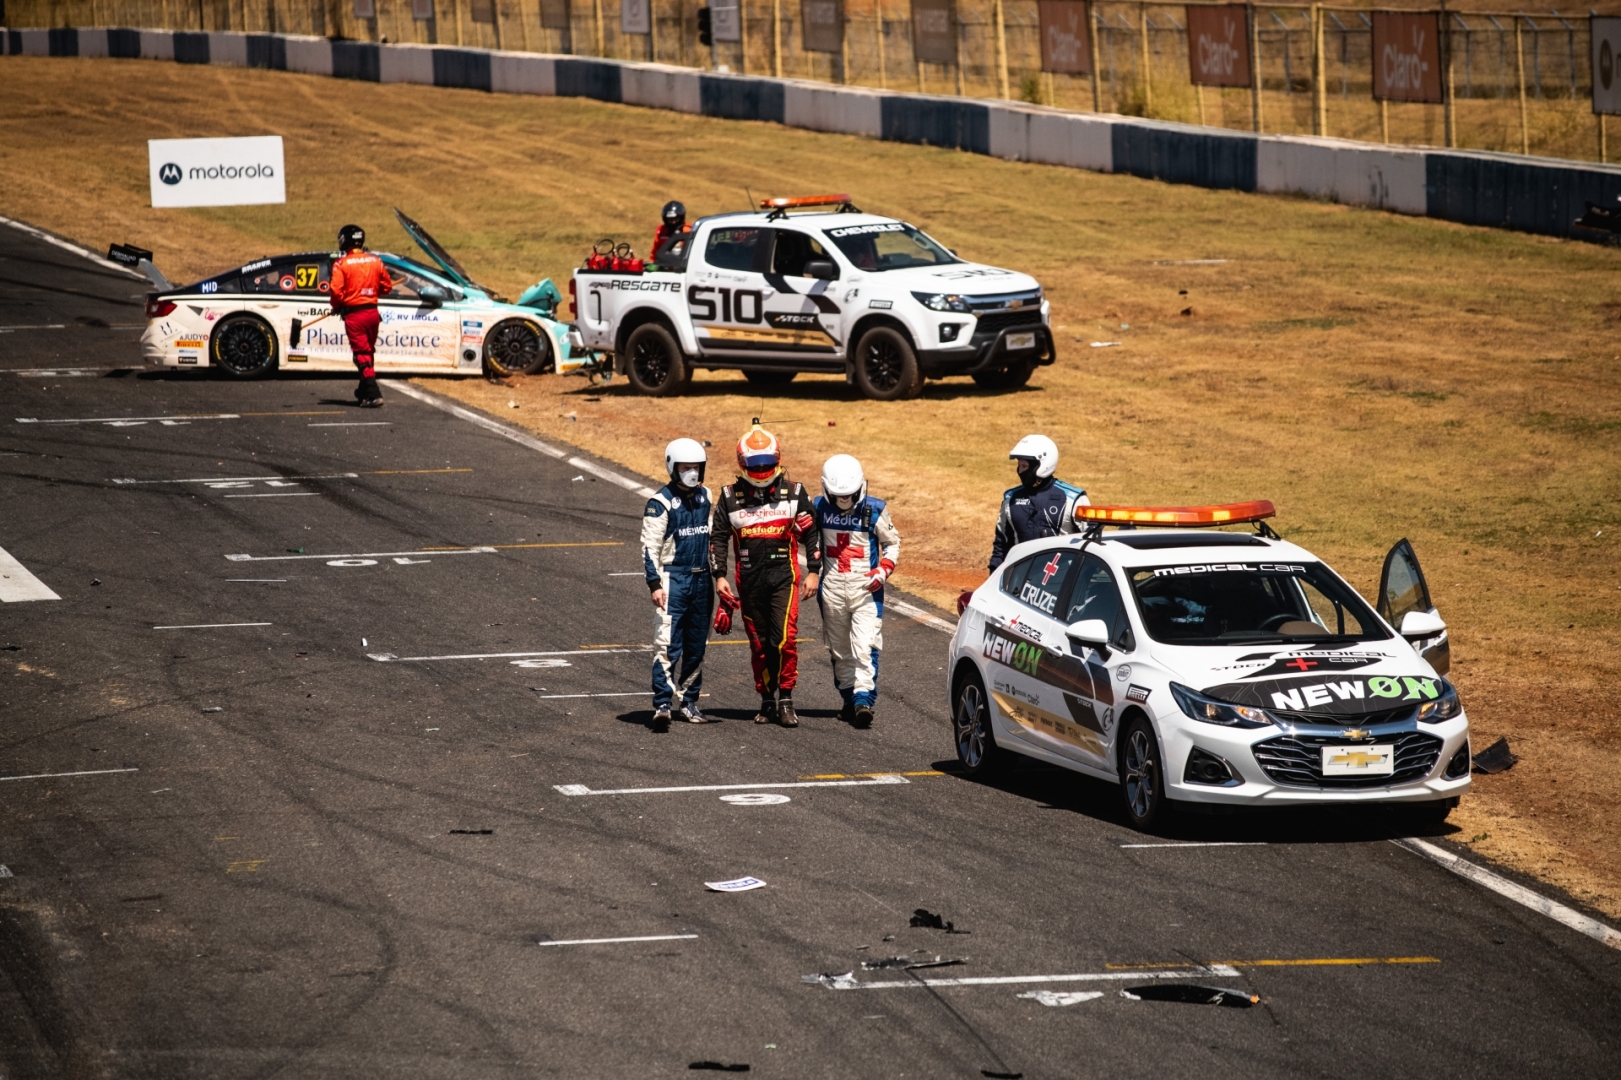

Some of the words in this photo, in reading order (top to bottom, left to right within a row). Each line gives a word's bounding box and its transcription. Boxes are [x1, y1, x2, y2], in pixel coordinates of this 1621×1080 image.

[1199, 34, 1233, 75] Claro
[1383, 45, 1421, 89] Claro
[189, 163, 274, 180] motorola
[830, 224, 905, 238] CHEVROLET
[297, 268, 318, 287] 37
[202, 282, 218, 293] MID
[687, 285, 763, 324] S10
[411, 314, 439, 322] IMOLA
[779, 314, 815, 323] STOCK
[823, 512, 862, 526] Médic
[1154, 564, 1257, 577] MEDICAL
[1260, 564, 1307, 573] CAR
[1020, 582, 1057, 614] CRUZE
[1014, 621, 1044, 643] MEDICAL
